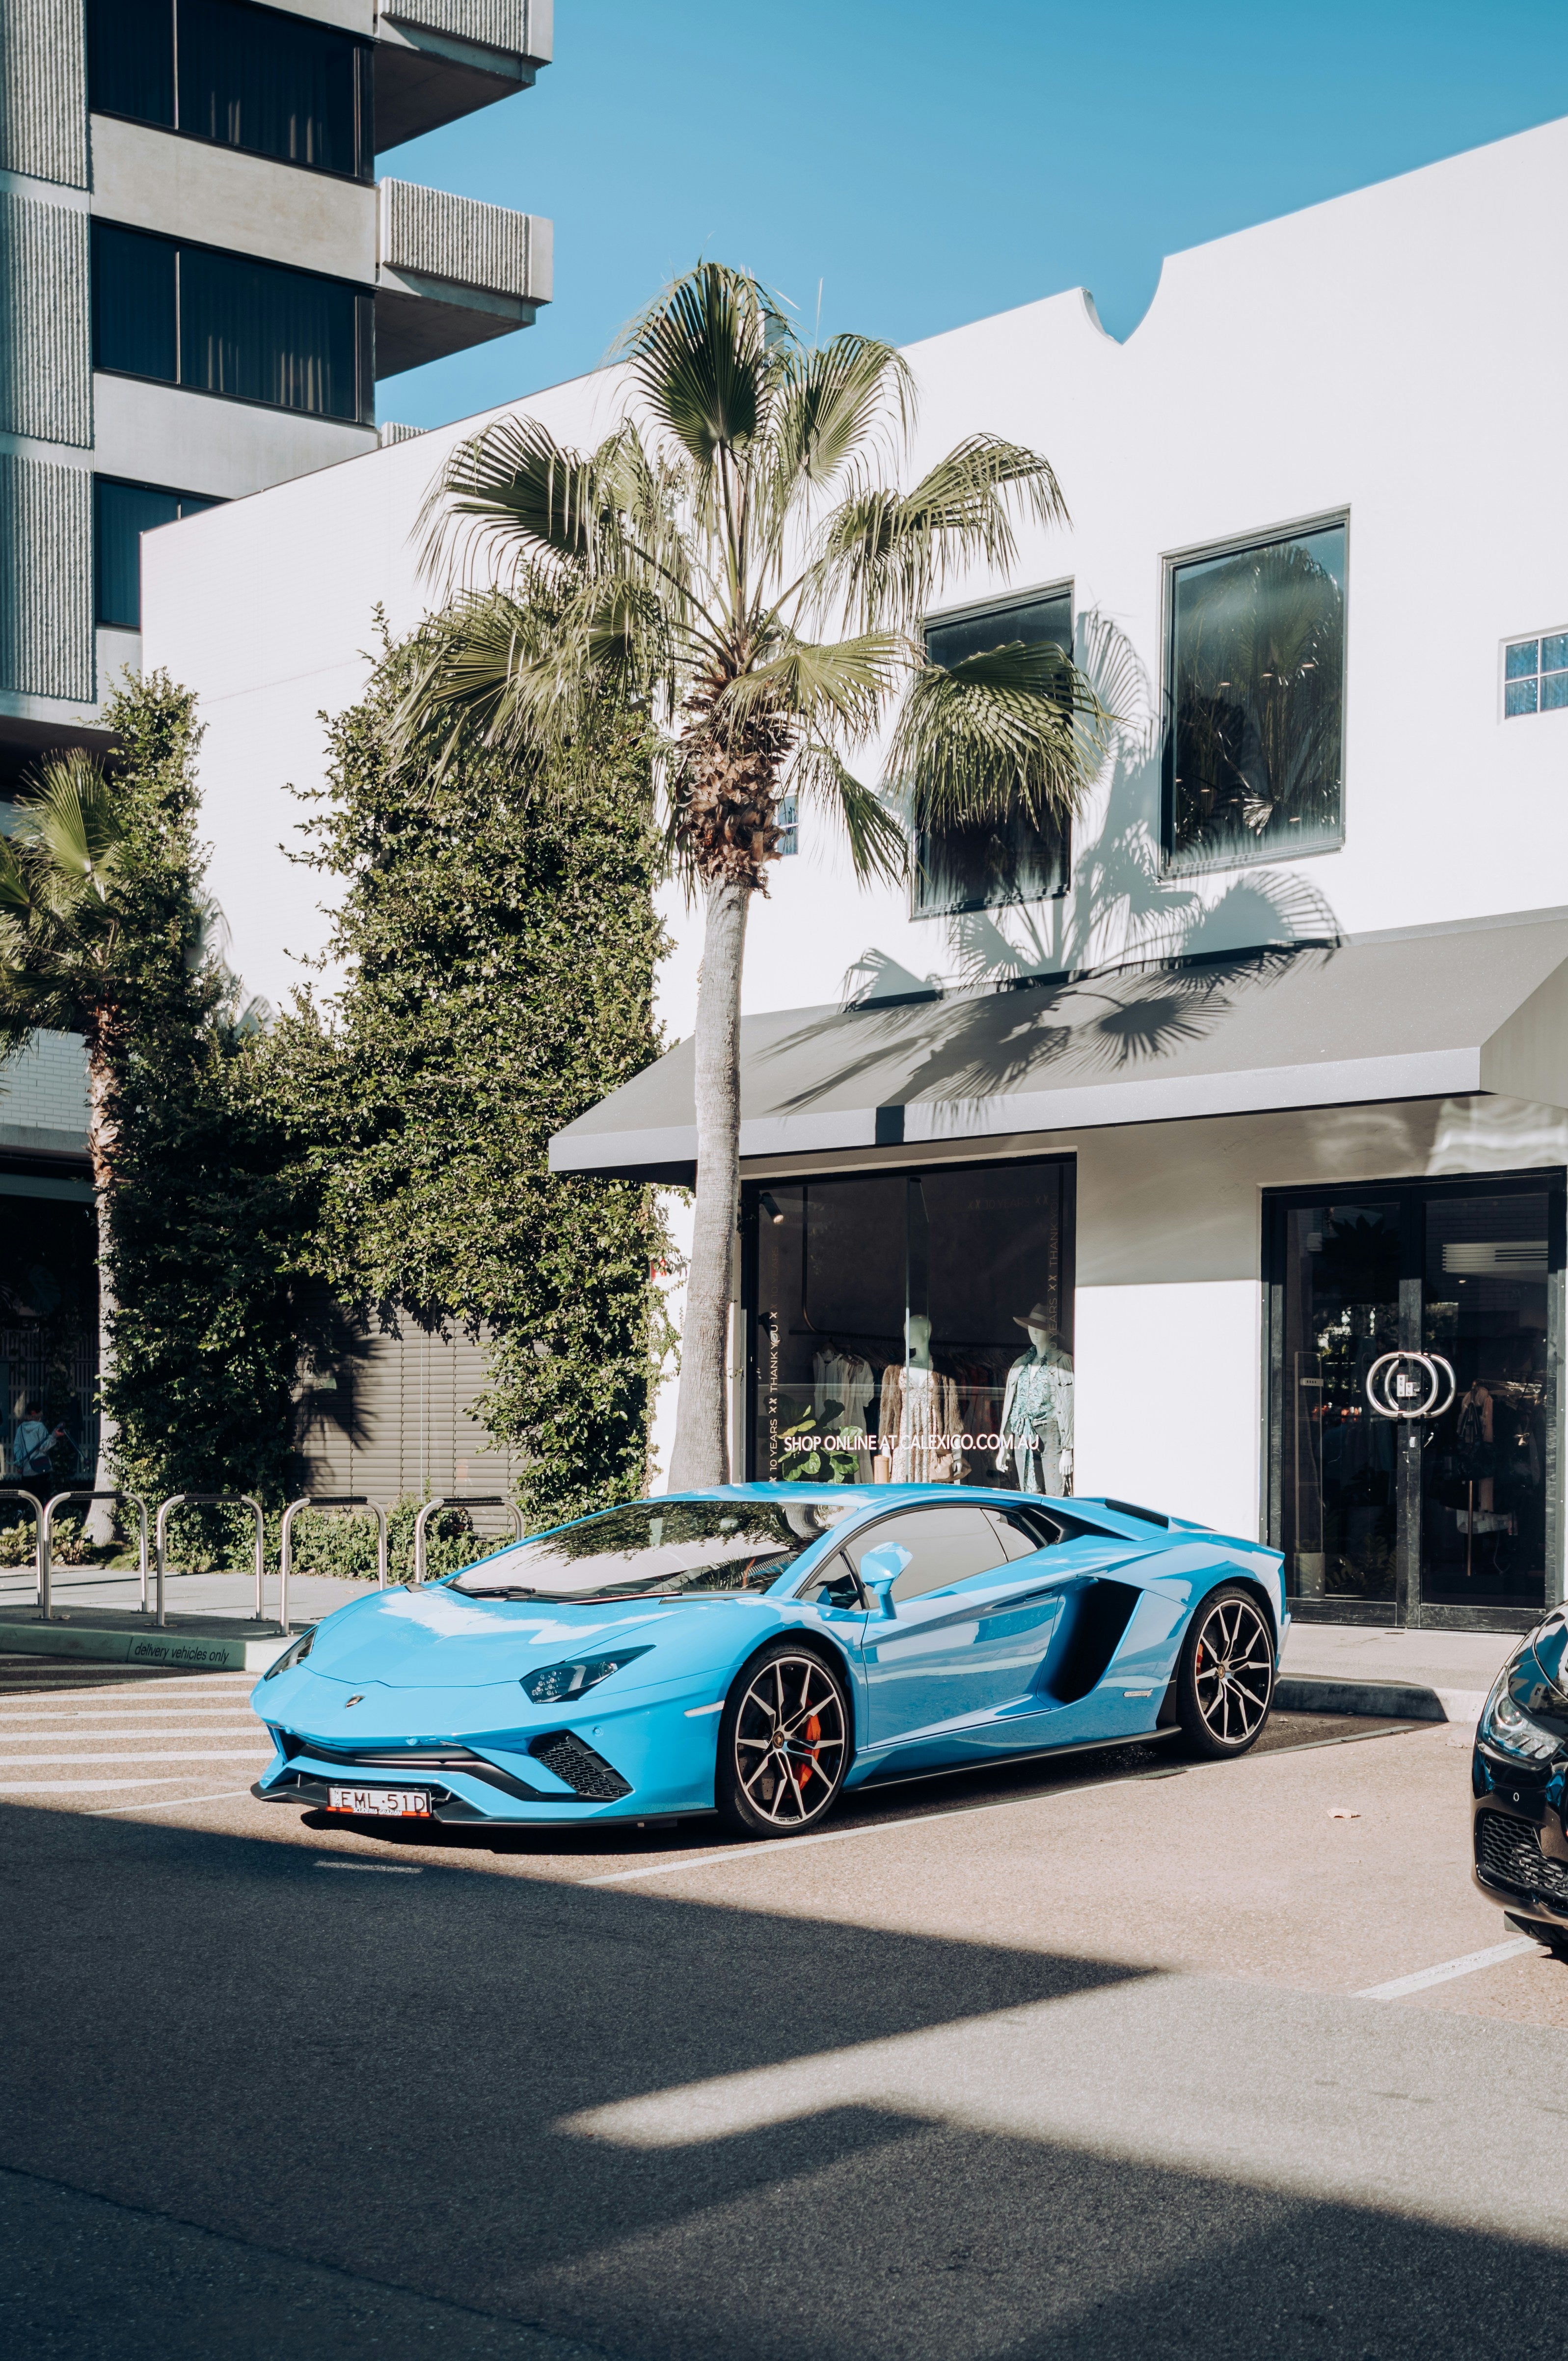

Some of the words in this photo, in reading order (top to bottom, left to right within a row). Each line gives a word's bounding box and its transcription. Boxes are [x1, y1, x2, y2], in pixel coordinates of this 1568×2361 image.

[998, 1197, 1030, 1208] YEARS
[1050, 1193, 1059, 1219] YOU
[1050, 1223, 1058, 1267] THANK
[771, 1246, 779, 1284] YEARS
[1049, 1297, 1057, 1339] YEARS
[770, 1324, 780, 1349] YOU
[770, 1351, 778, 1393] THANK
[784, 1436, 821, 1452] SHOP
[824, 1435, 877, 1451] ONLINE
[879, 1435, 897, 1450] AT
[900, 1433, 1039, 1451] CALEXICO.COM.AU
[770, 1459, 778, 1471] 10
[135, 1642, 169, 1660] delivery
[171, 1646, 207, 1661] vehicles
[209, 1648, 229, 1665] only
